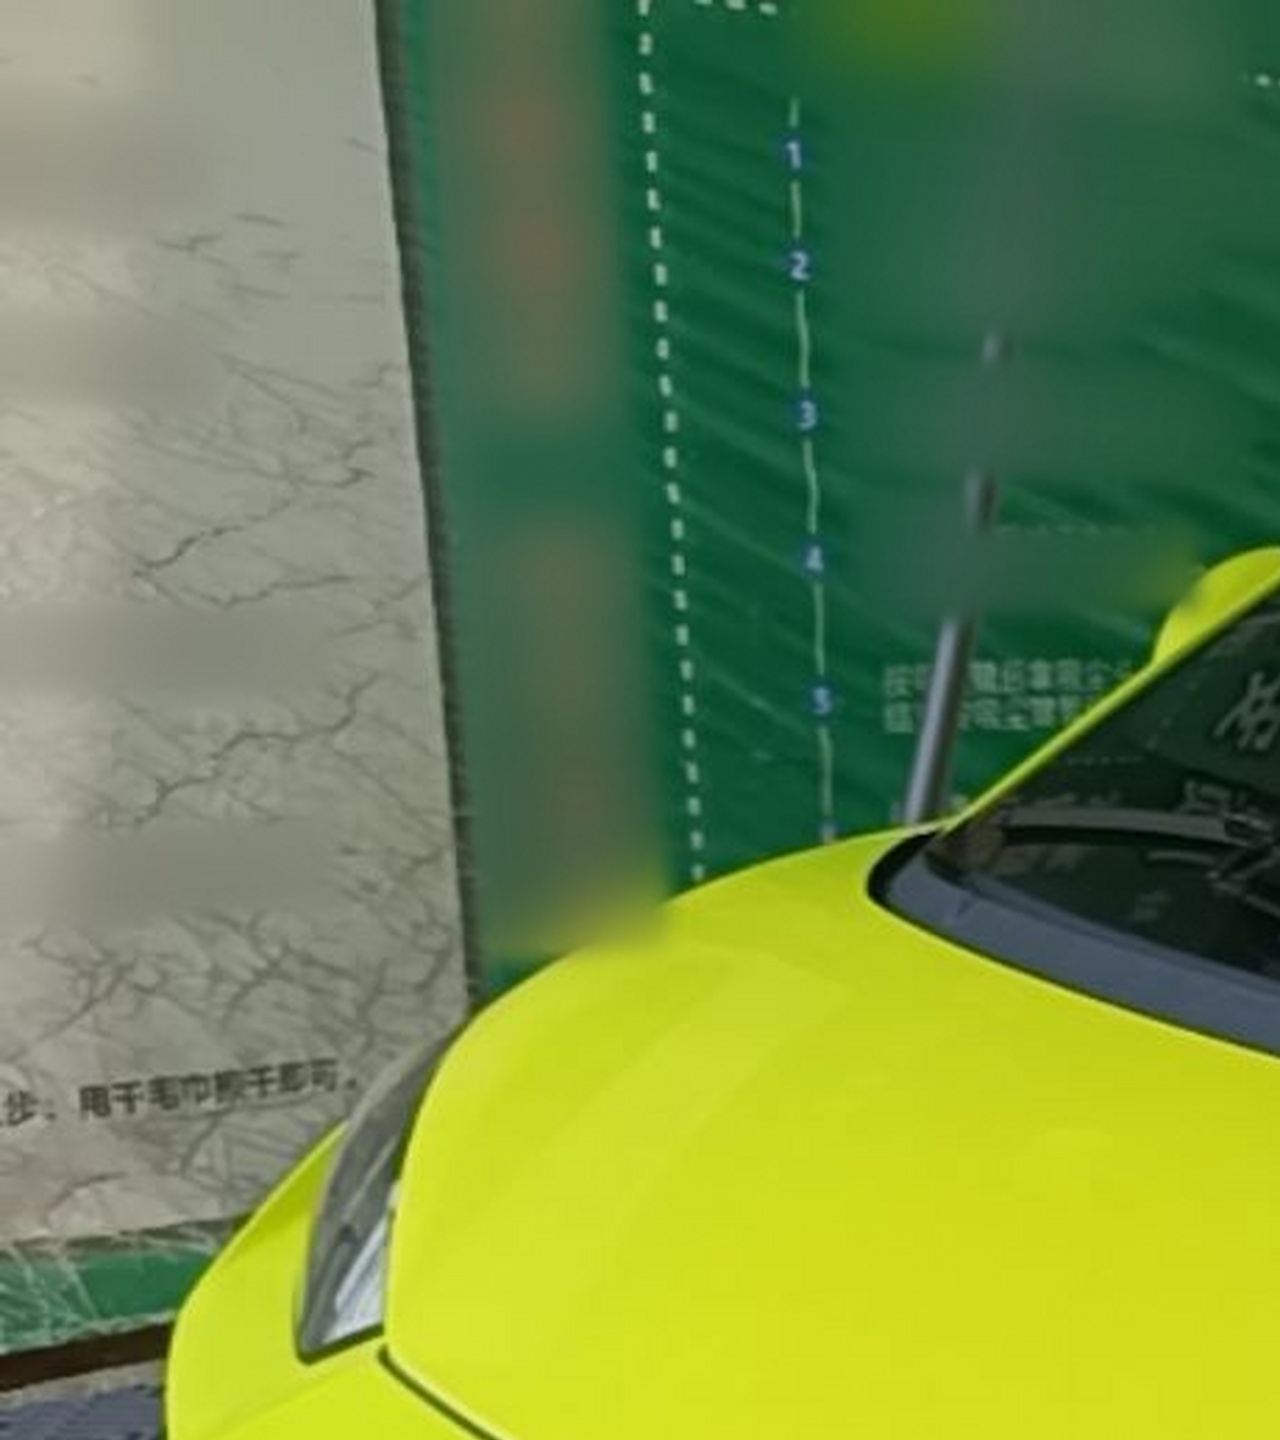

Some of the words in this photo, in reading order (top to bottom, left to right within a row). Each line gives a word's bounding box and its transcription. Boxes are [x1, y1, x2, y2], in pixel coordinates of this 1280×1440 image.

[786, 140, 802, 167] 1
[791, 251, 810, 280] 2
[799, 401, 817, 429] 3
